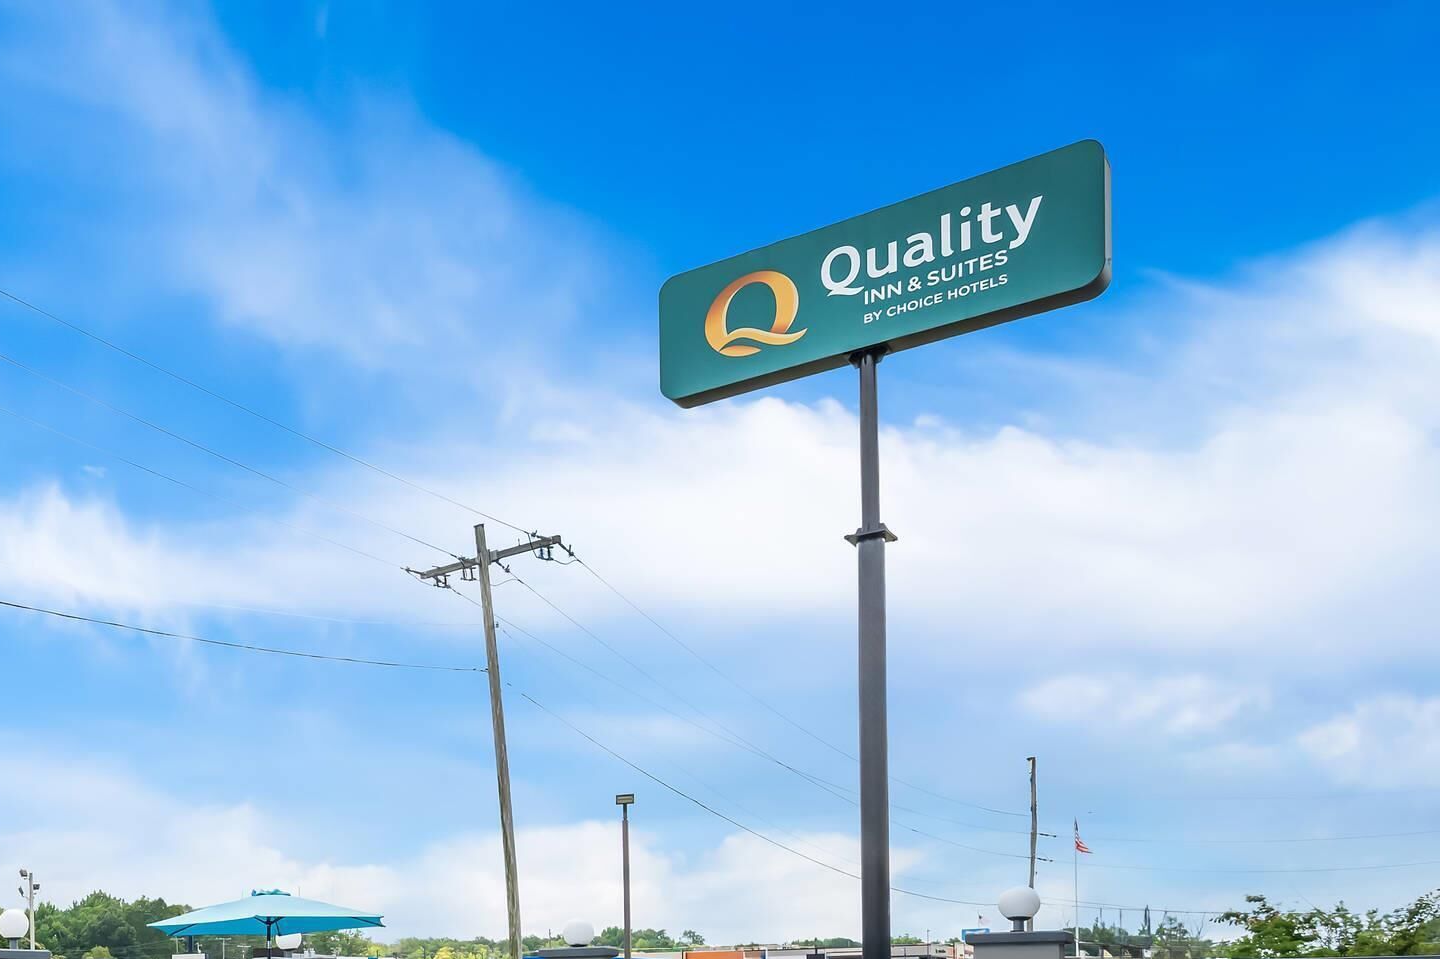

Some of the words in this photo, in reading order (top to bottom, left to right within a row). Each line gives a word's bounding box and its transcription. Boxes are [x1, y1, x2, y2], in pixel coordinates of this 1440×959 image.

[820, 195, 1044, 297] Quality
[863, 280, 903, 305] INN
[907, 275, 922, 292] &
[926, 250, 1009, 286] SUITES
[704, 270, 808, 358] Q
[863, 309, 883, 324] BY
[886, 292, 944, 317] CHOICE
[947, 273, 1009, 300] HOTELS
